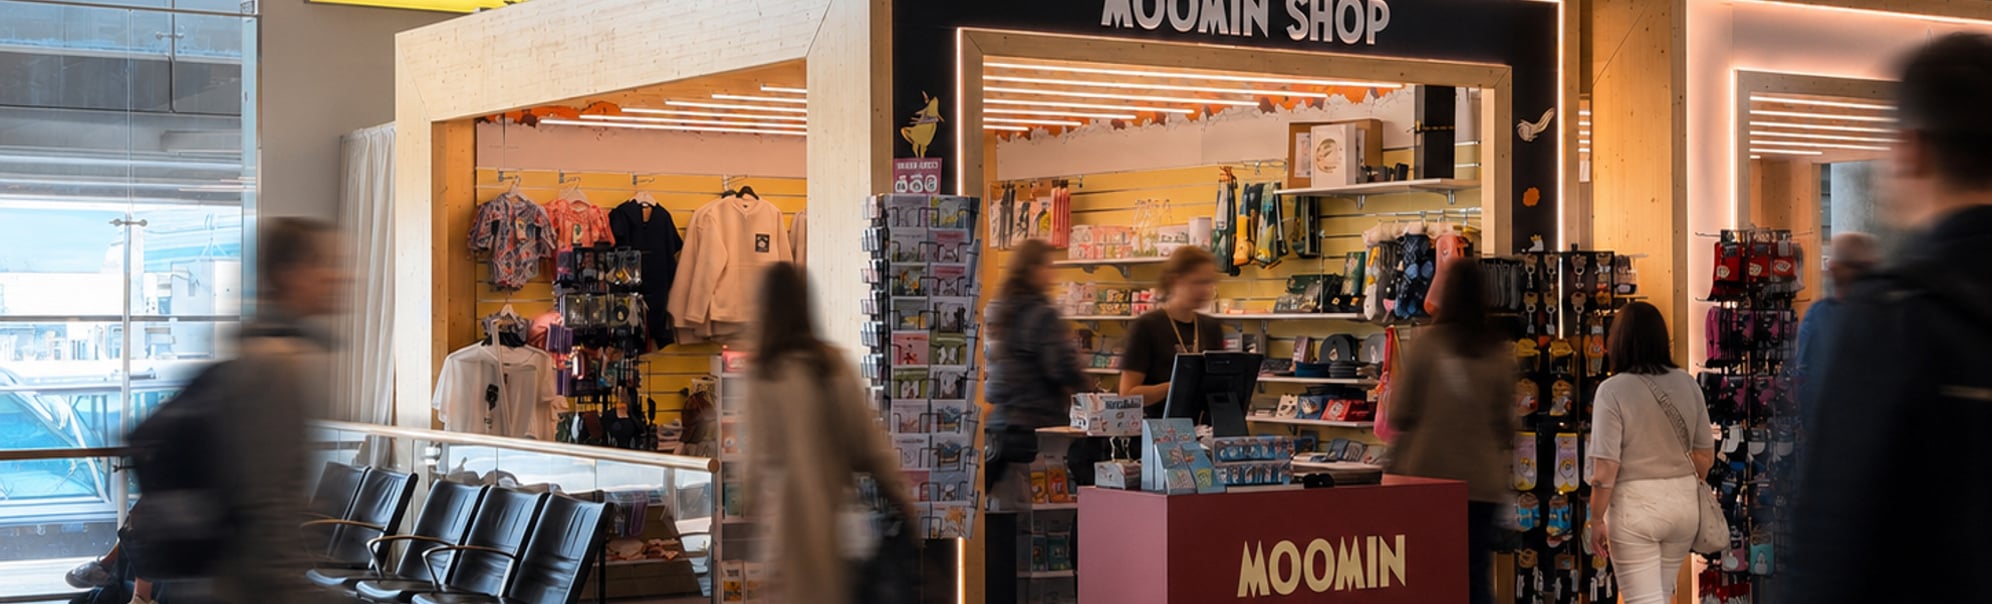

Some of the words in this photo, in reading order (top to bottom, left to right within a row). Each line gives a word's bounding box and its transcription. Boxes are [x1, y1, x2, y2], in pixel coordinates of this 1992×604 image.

[1101, 0, 1269, 38] MOOMIN
[1286, 0, 1391, 45] SHOP
[1237, 534, 1406, 598] MOOMIN
